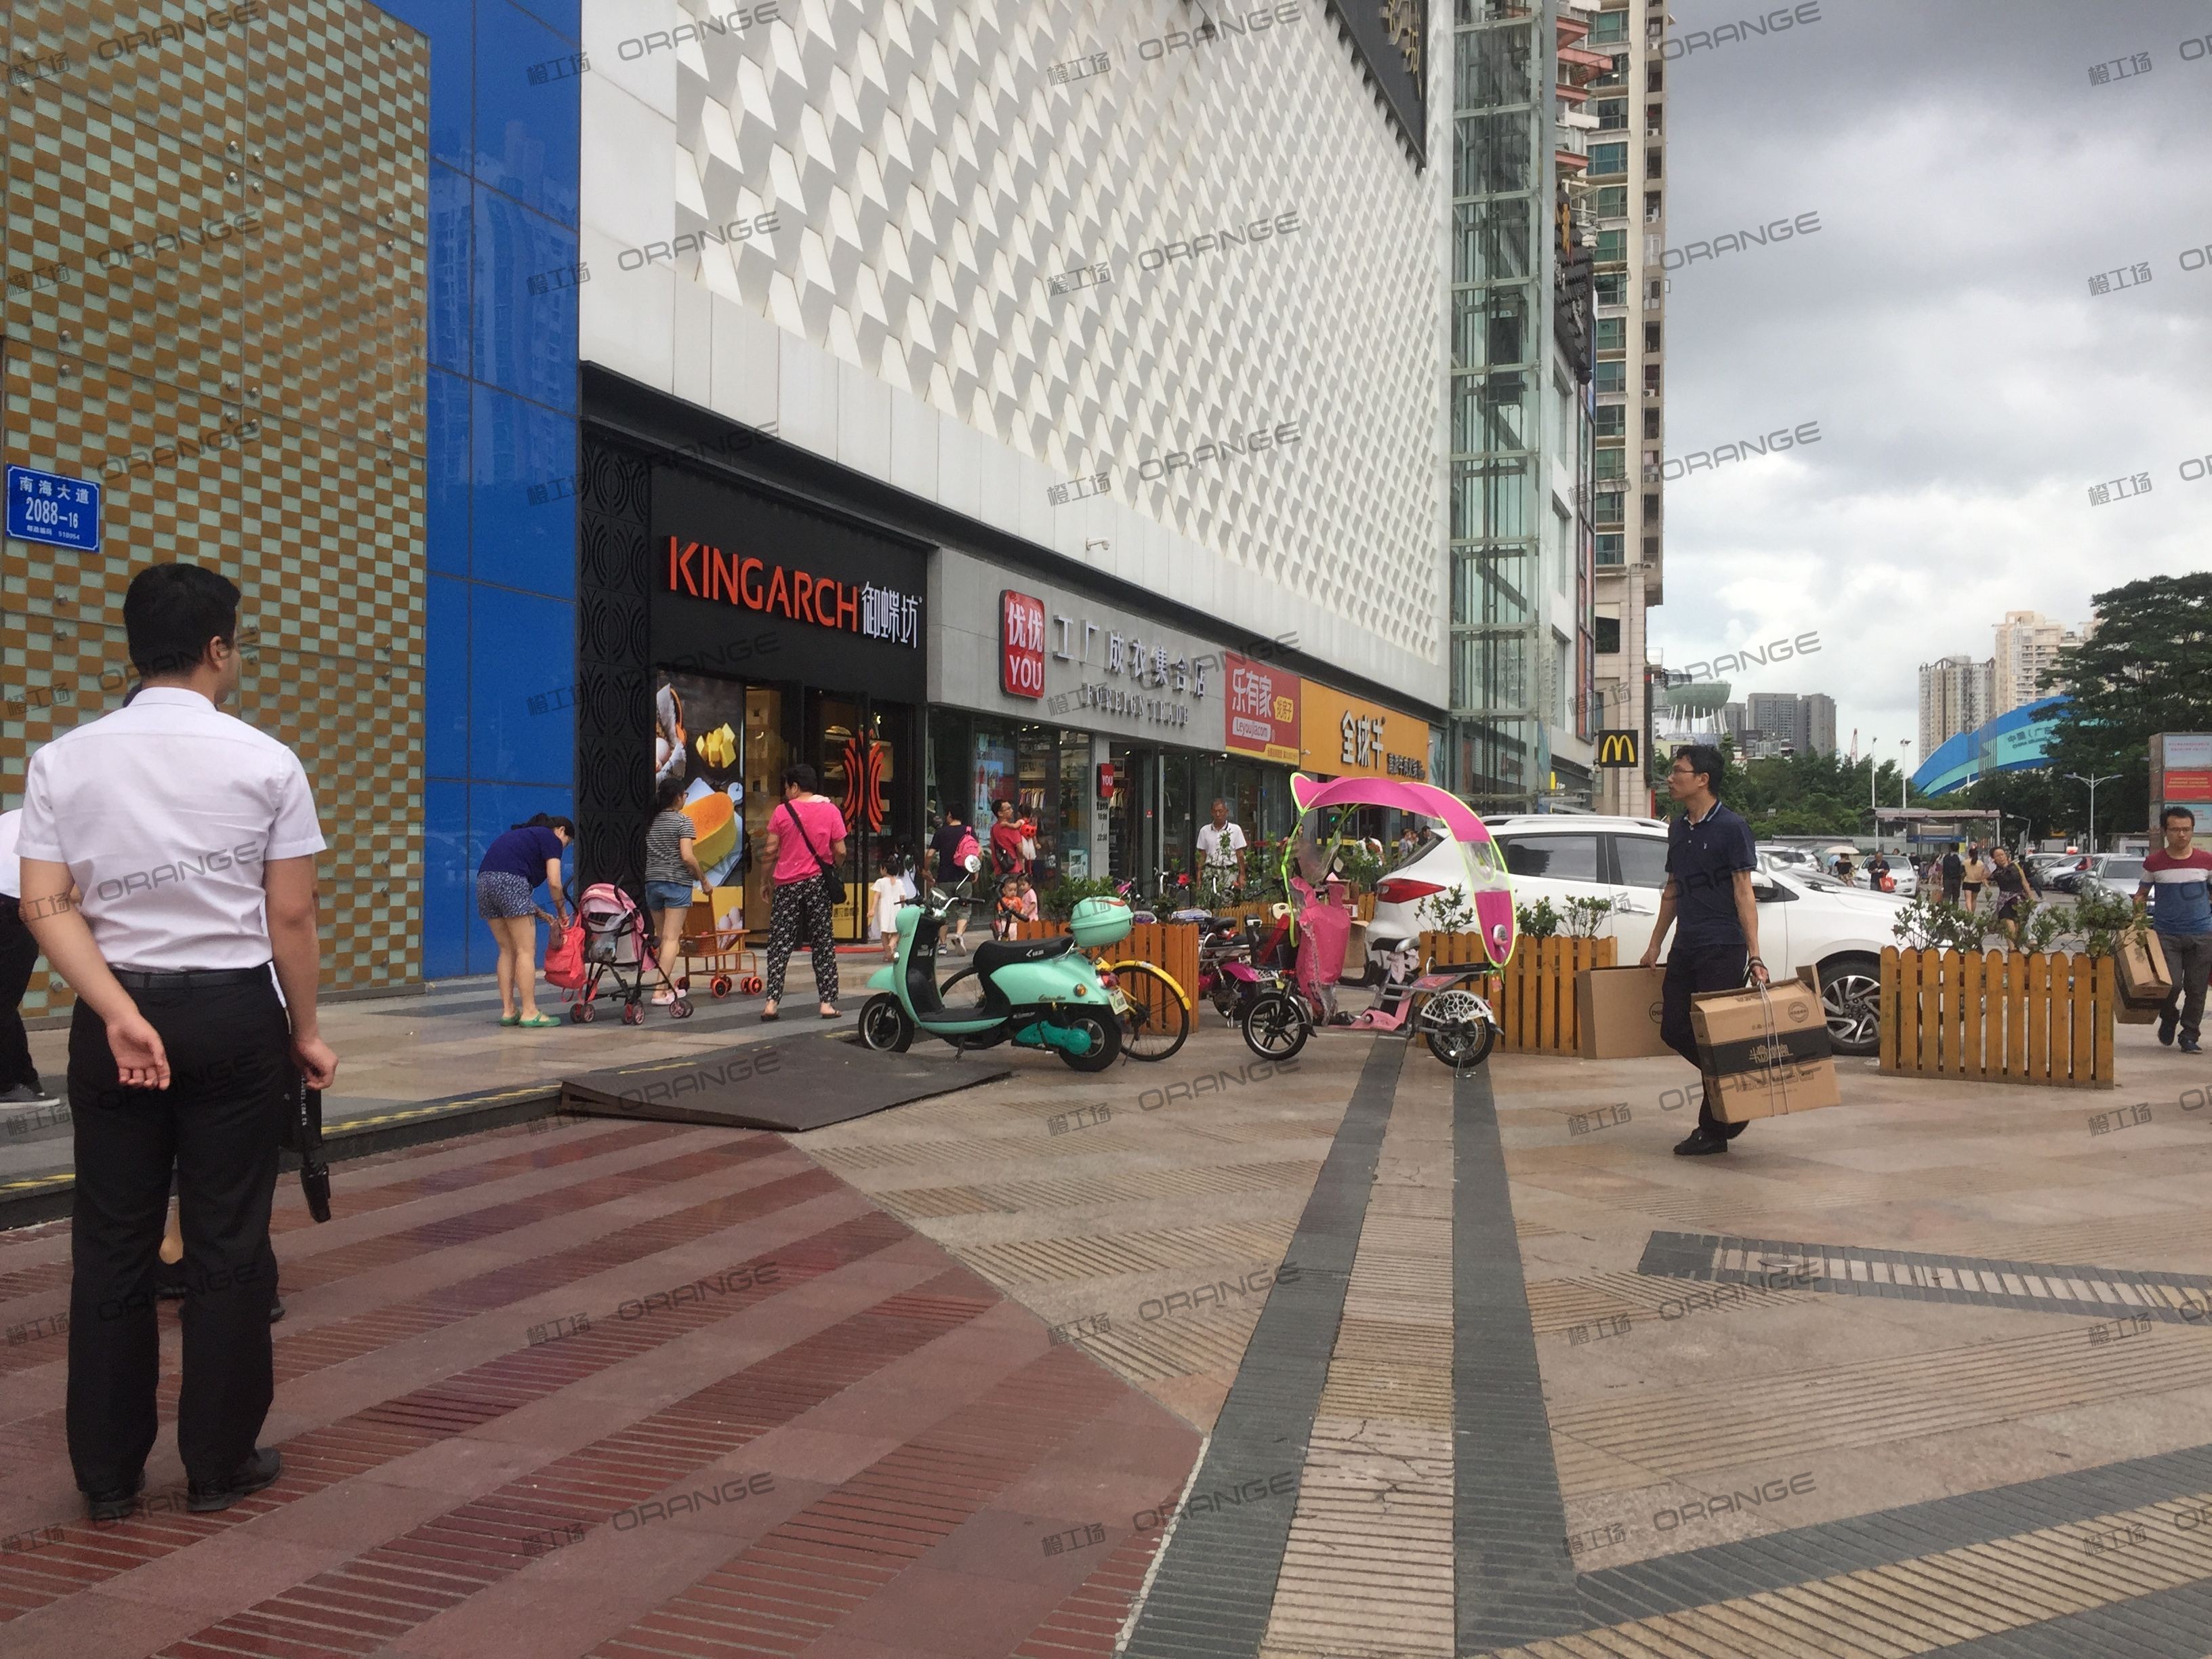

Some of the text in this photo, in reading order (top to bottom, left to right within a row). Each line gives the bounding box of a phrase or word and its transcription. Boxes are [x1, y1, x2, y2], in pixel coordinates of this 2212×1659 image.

[19, 476, 89, 504] 南海大道
[25, 496, 79, 529] 2088-16
[669, 535, 858, 632] KINGARCH
[1007, 600, 1043, 653] 优优
[1009, 655, 1042, 691] YOU
[1054, 614, 1206, 697] 工厂成衣集合店
[1231, 668, 1272, 718] 乐有家
[1101, 775, 1113, 786] YOU
